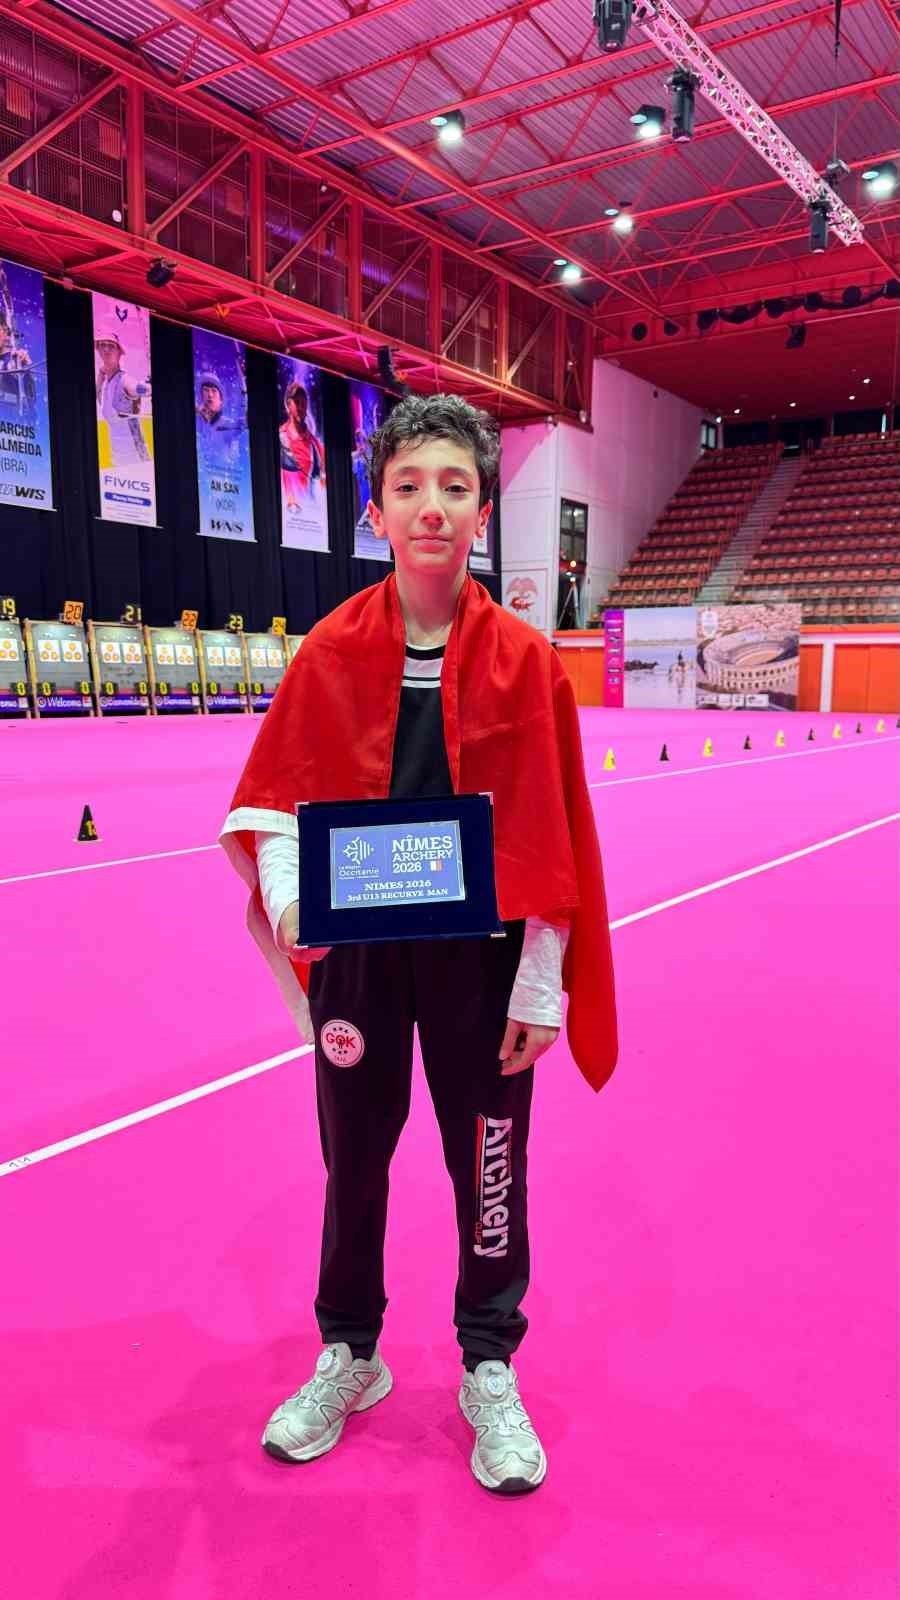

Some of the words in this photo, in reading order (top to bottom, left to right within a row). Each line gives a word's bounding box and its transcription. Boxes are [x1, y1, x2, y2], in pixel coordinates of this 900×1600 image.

[1, 456, 28, 477] (BRA)
[104, 474, 150, 492] FIVICS
[2, 598, 16, 616] 19
[66, 604, 81, 619] 20
[125, 604, 142, 621] 21
[229, 614, 244, 630] 23
[391, 834, 454, 853] NÎMES
[391, 848, 454, 863] ARCHERY
[392, 861, 423, 874] 2026
[364, 881, 404, 891] NIMES
[346, 893, 361, 903] 3rd
[381, 890, 424, 899] RECURVE
[427, 887, 449, 897] MAN
[473, 1117, 513, 1258] Archery
